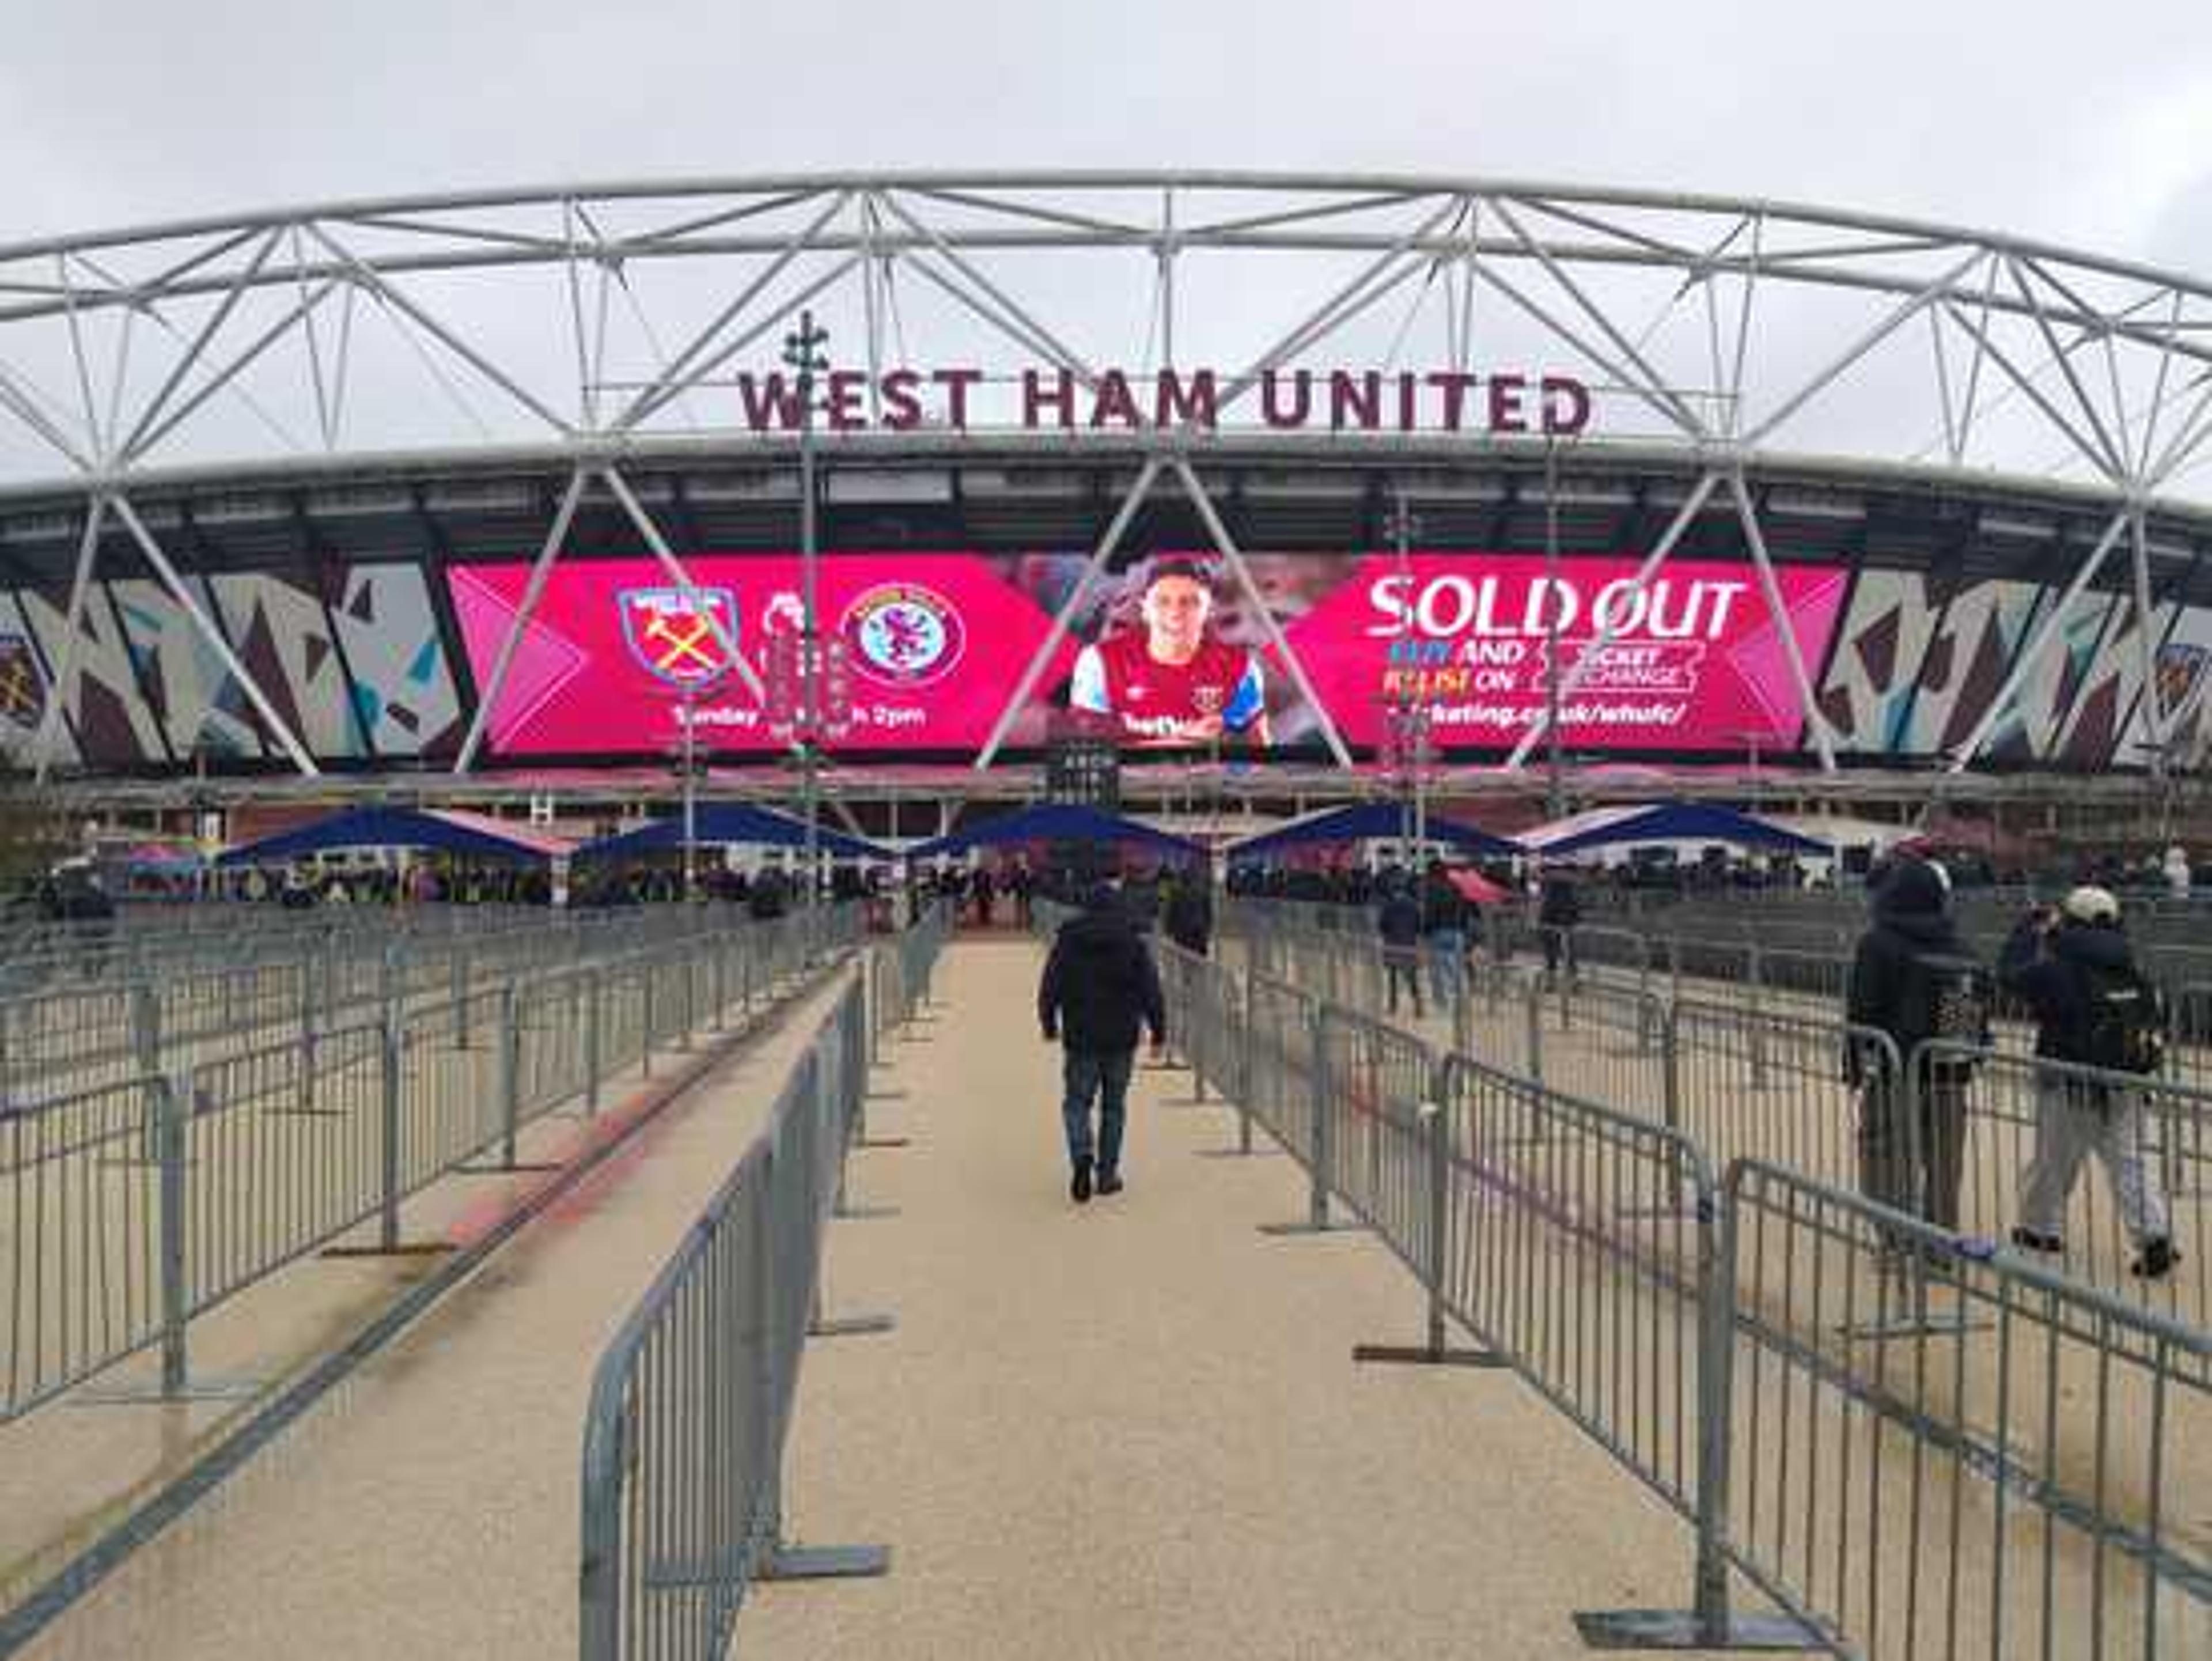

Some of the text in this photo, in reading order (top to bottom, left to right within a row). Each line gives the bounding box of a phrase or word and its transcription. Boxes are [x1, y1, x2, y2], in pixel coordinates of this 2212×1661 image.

[738, 369, 1590, 434] WEST HAM UNITED
[1367, 576, 1748, 640] SOLD OUT
[1459, 639, 1525, 664] AND
[1475, 669, 1517, 691] ON
